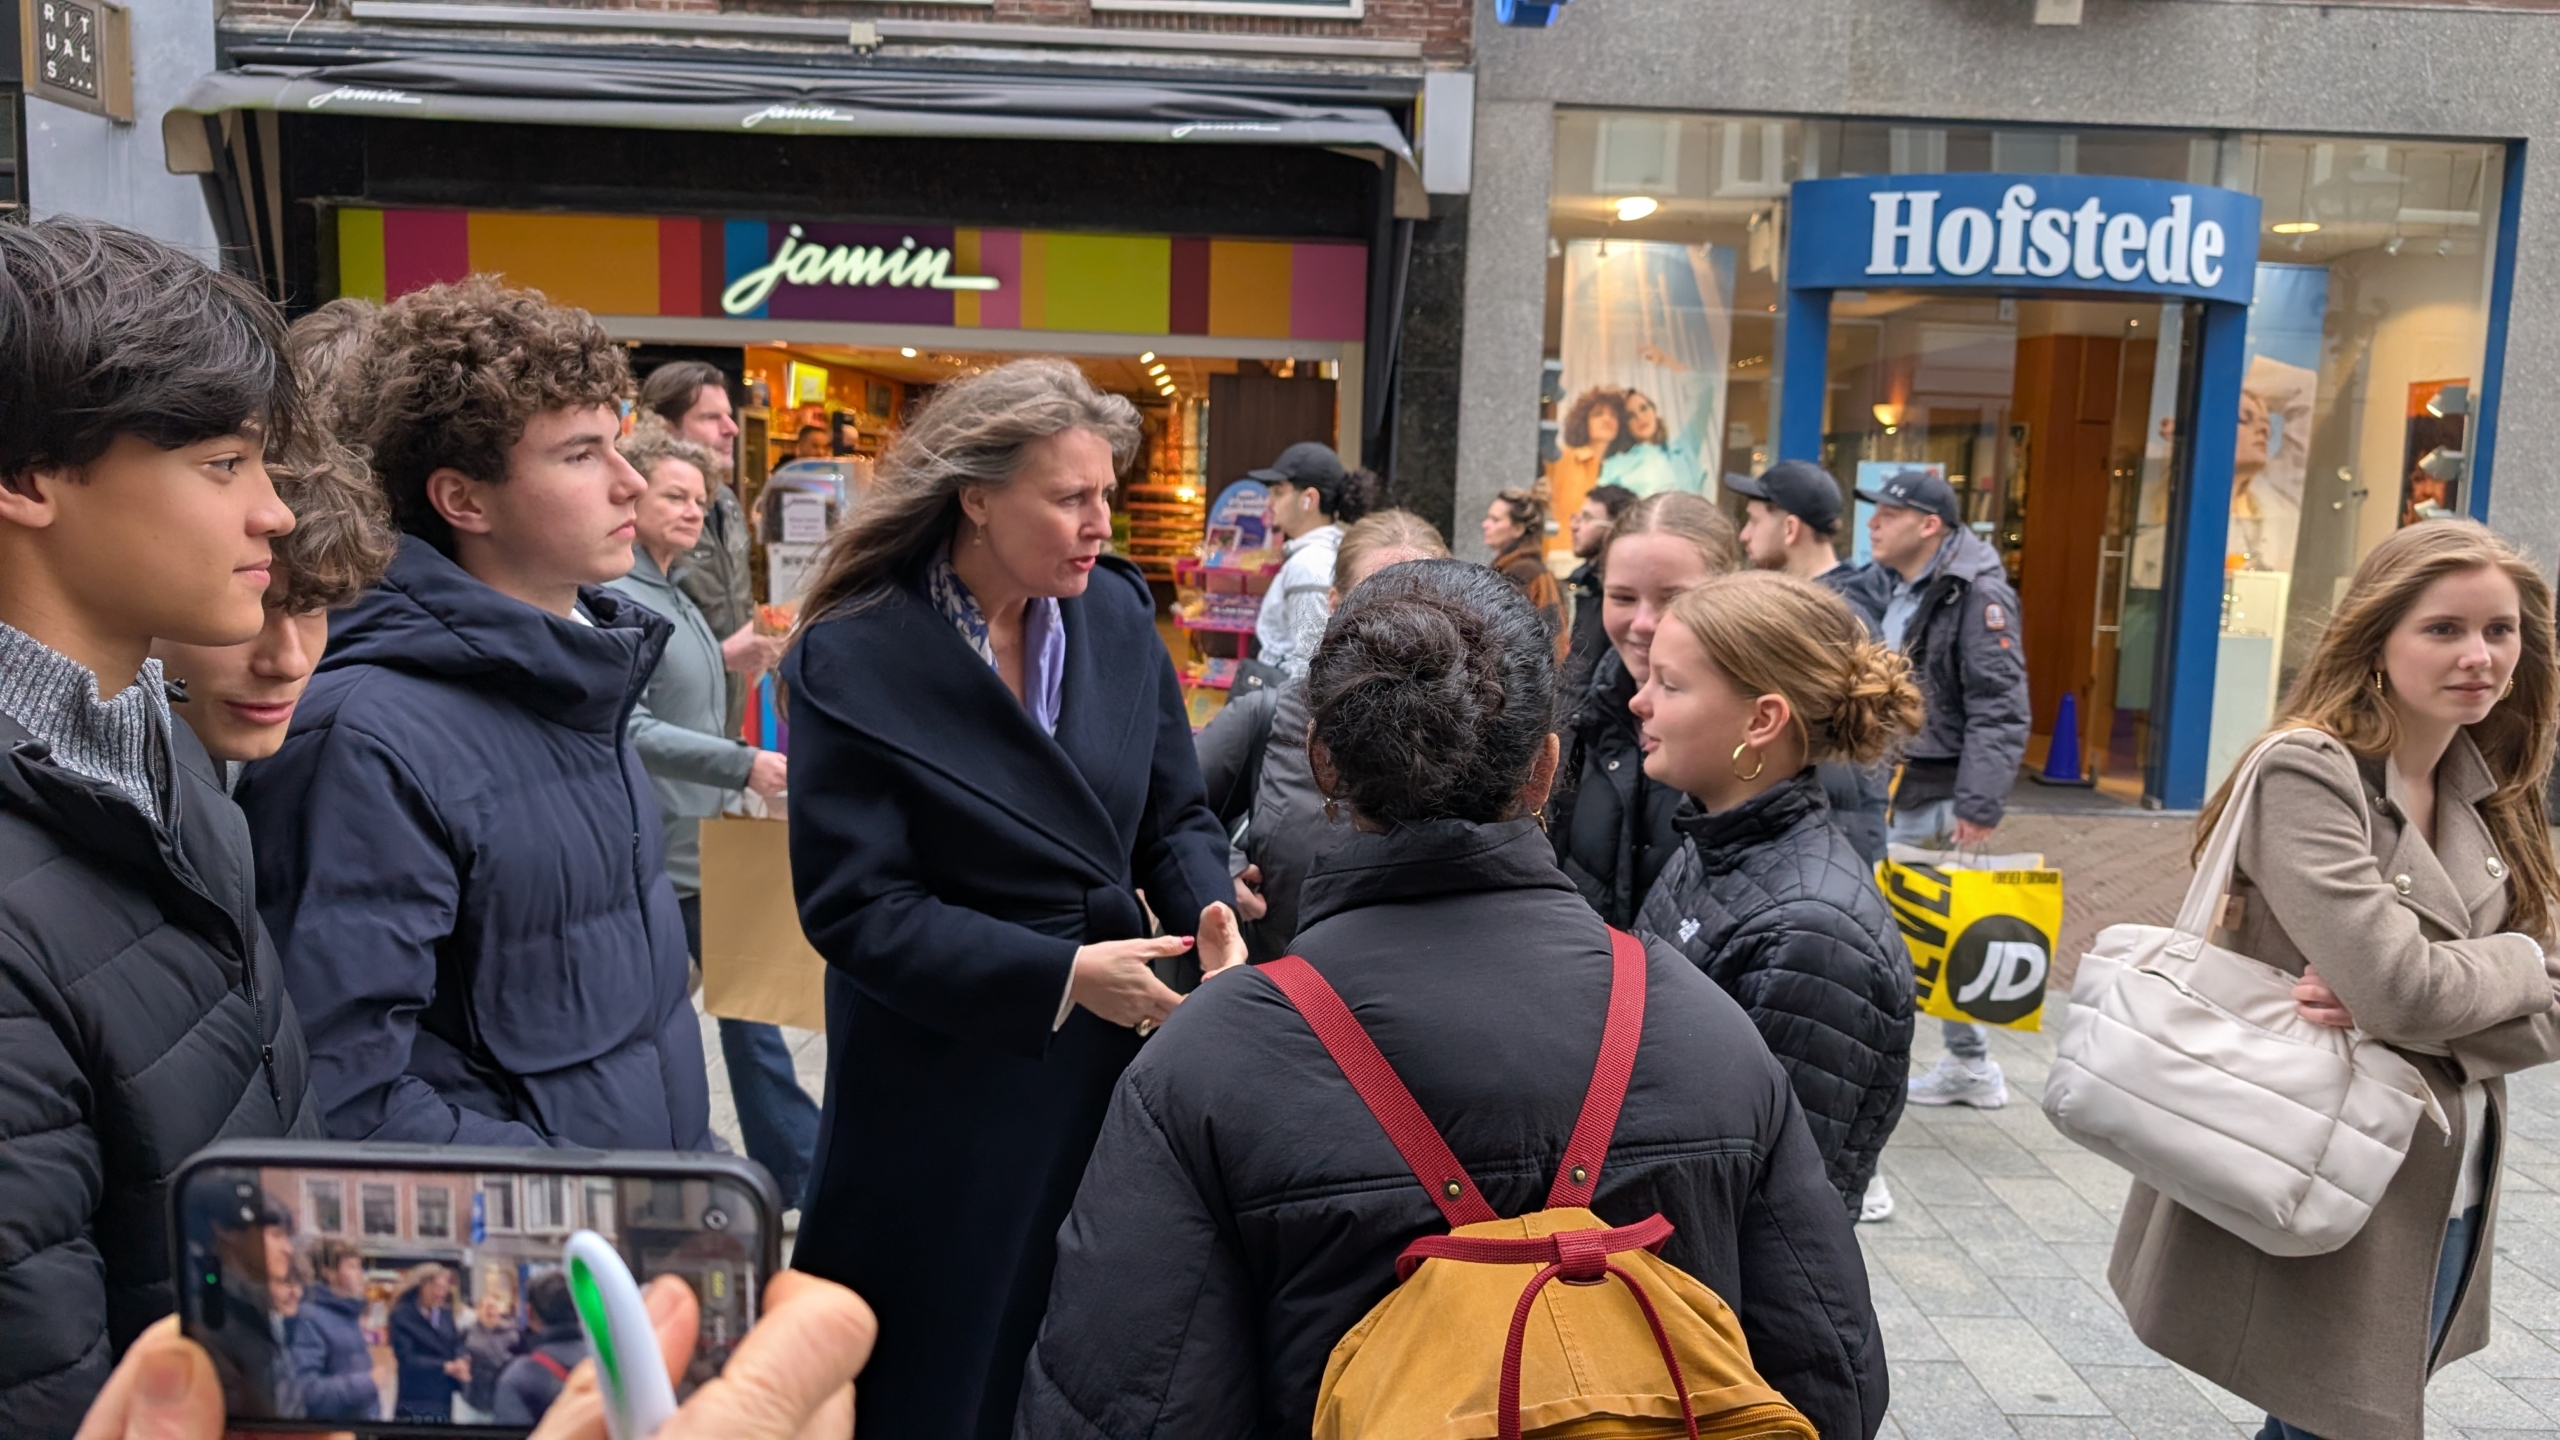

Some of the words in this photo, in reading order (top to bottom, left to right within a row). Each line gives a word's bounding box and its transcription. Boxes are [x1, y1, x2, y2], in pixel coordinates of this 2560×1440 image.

[721, 224, 1000, 314] jamin
[1865, 183, 2226, 288] Hofstede
[1957, 941, 2046, 1003] JD
